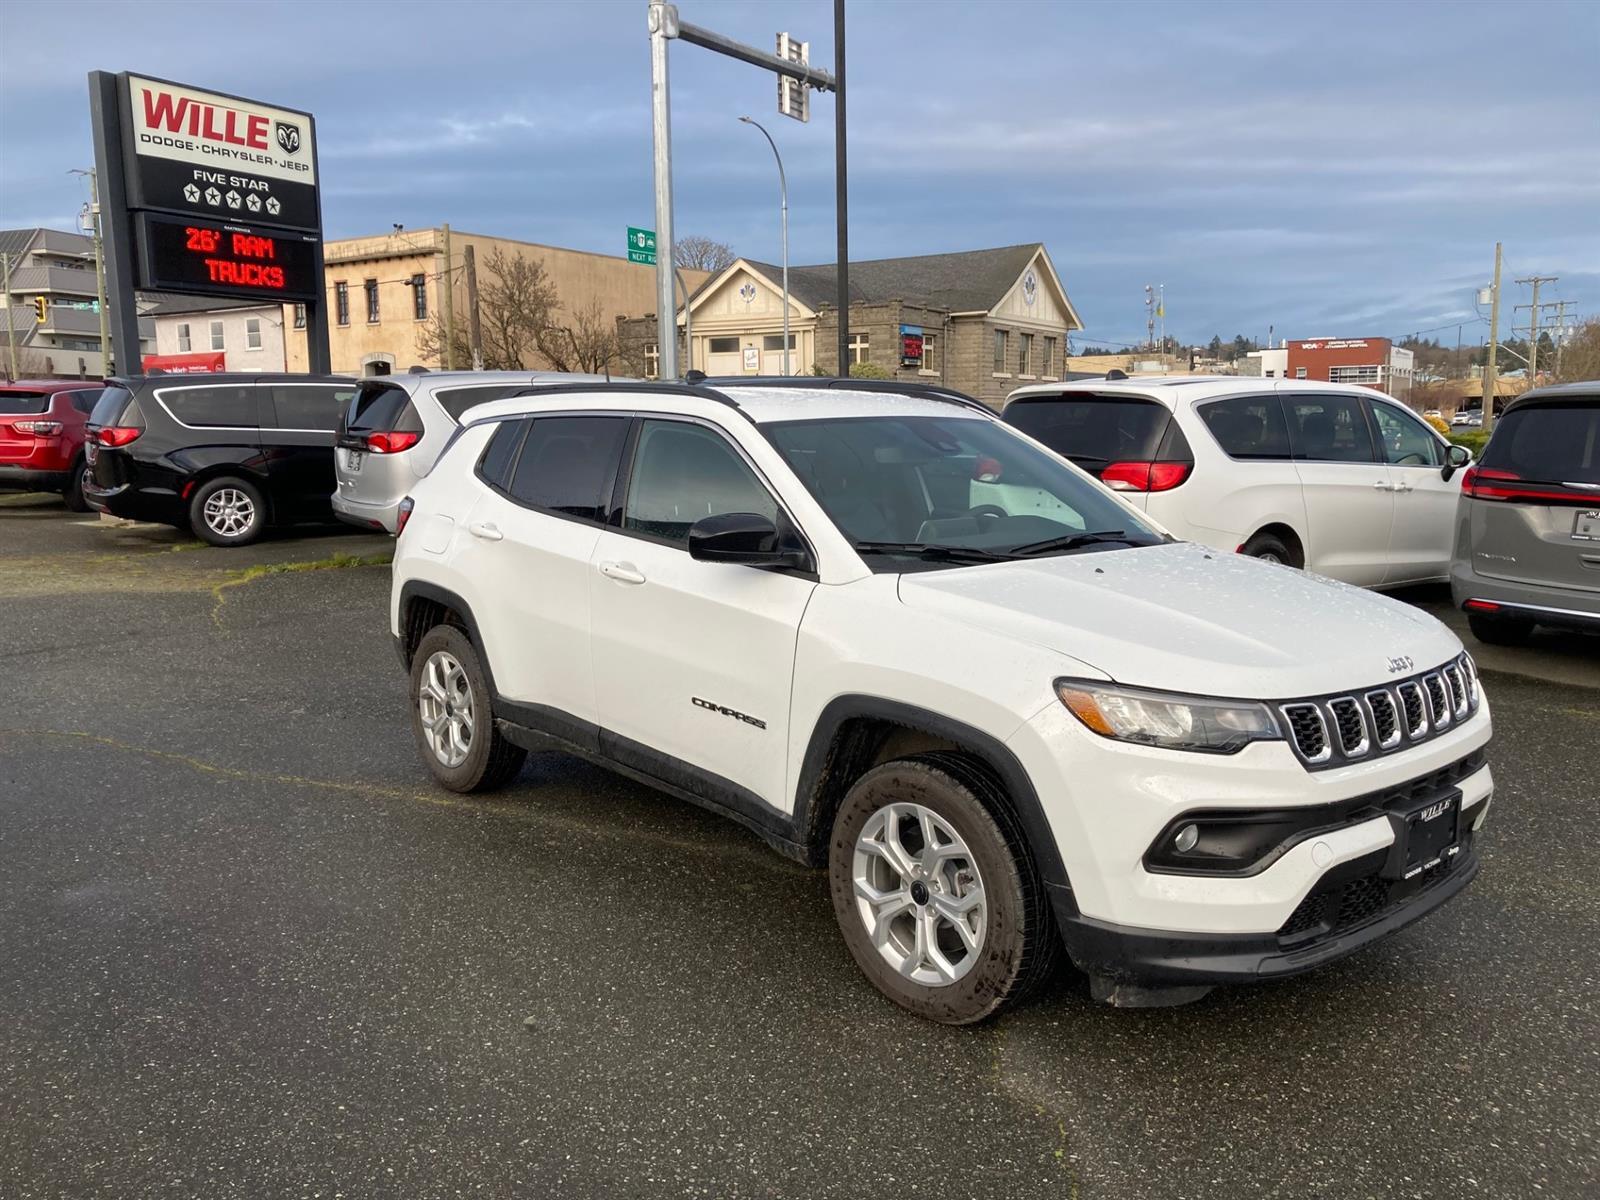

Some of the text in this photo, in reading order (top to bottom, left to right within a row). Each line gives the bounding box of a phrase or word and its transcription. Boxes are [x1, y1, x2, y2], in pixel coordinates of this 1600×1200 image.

[141, 88, 270, 151] WILLE
[141, 134, 310, 172] DODGE CHRYSLER JEEP
[193, 170, 270, 192] FIVE STAR
[186, 227, 274, 258] 26' RAM
[632, 252, 646, 262] NEXT
[205, 259, 284, 288] TRUCKS
[1385, 656, 1414, 673] Jeep
[691, 697, 767, 730] COMPASS
[1421, 800, 1452, 820] WILLE
